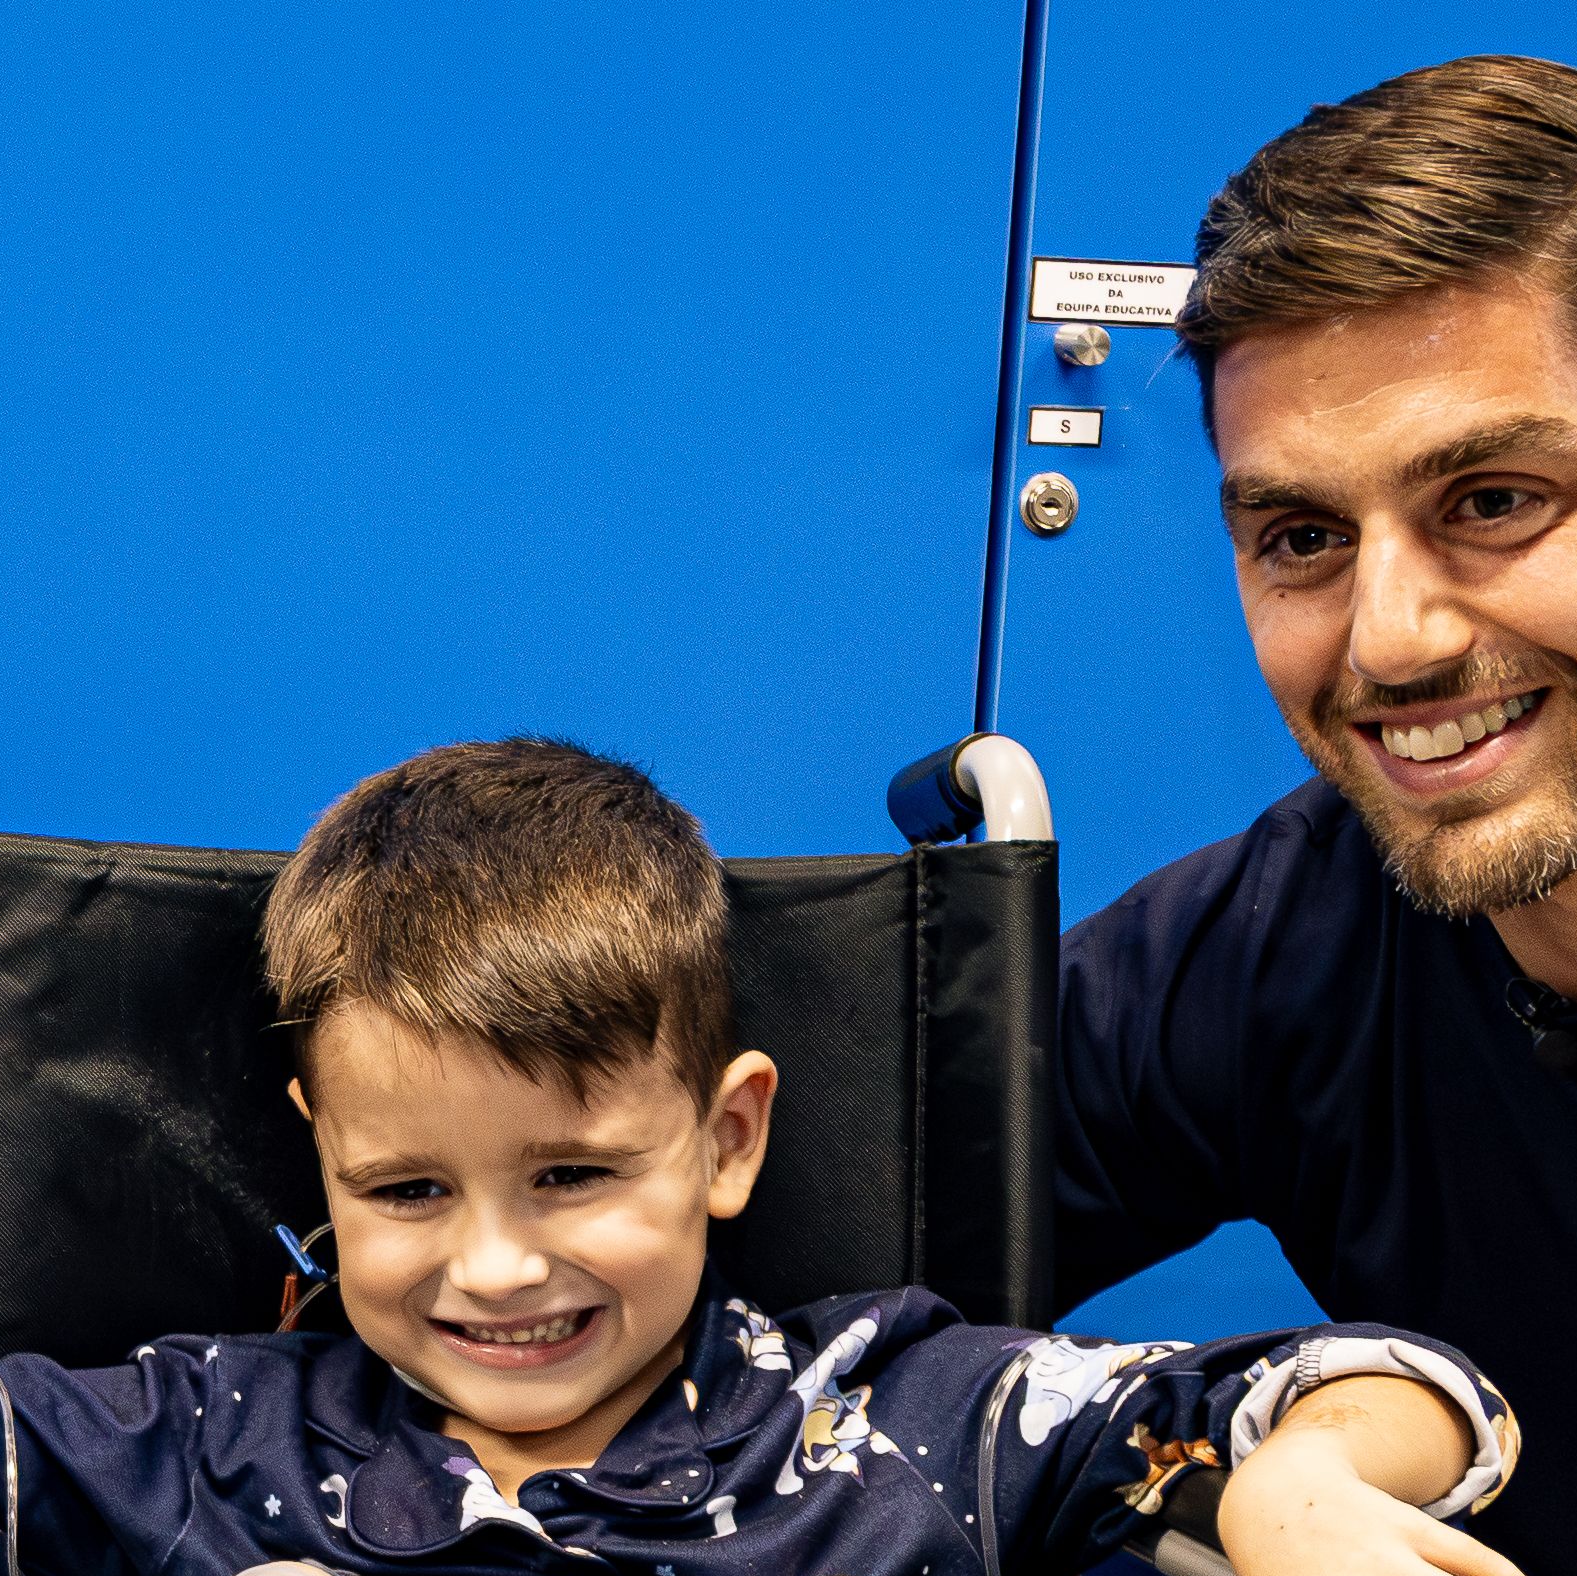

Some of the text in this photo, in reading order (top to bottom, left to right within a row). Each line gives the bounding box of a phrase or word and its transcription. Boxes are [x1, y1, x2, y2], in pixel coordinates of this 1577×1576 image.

[1069, 271, 1165, 284] USO EXCLUSIVO
[1108, 289, 1124, 298] DA
[1056, 302, 1172, 316] EQUIPA EDUCATIVA
[1060, 419, 1071, 433] S
